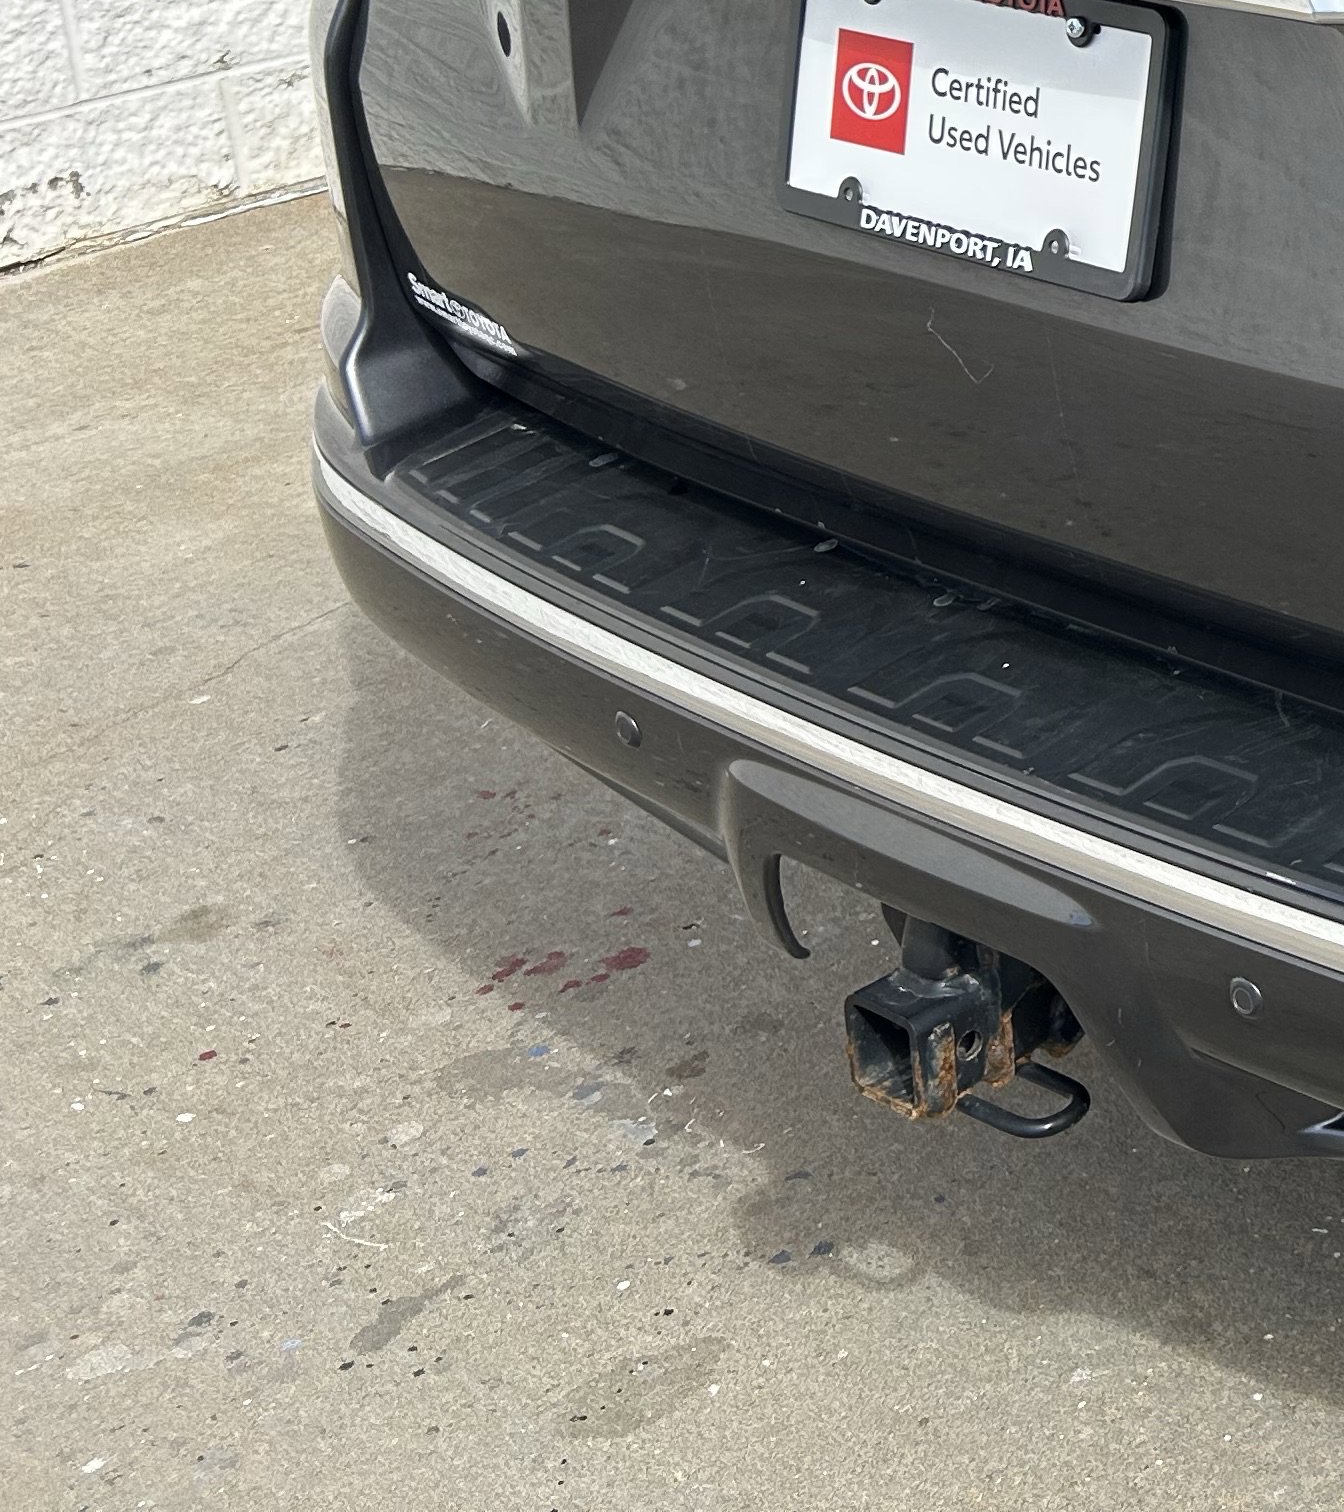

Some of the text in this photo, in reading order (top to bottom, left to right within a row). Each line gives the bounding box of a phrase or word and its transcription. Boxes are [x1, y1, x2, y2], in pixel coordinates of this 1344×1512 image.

[931, 67, 1041, 119] Certified
[928, 113, 1101, 182] Used Vehicles
[860, 208, 1034, 272] DAVENPORT, IA
